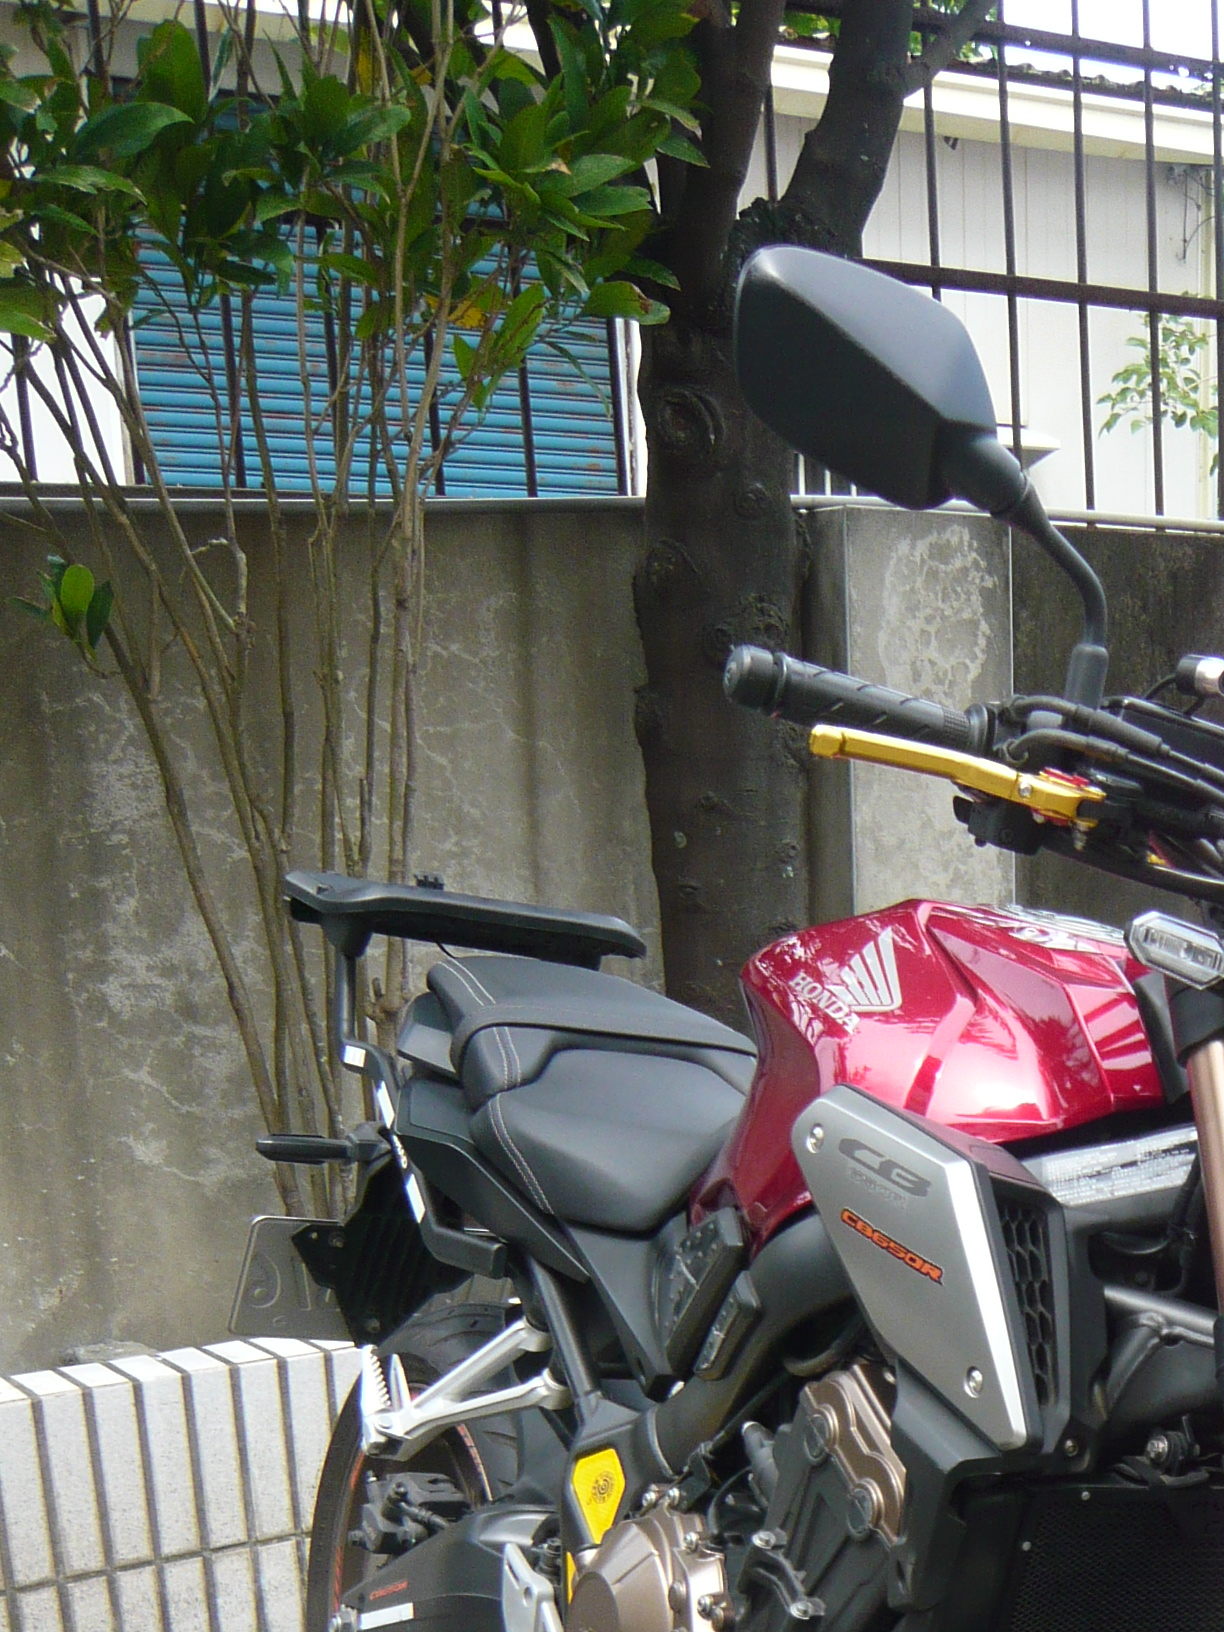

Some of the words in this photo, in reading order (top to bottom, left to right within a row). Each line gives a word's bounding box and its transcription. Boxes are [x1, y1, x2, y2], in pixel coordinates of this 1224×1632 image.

[789, 972, 860, 1035] HONDA
[838, 1138, 931, 1197] CB
[841, 1207, 943, 1284] CB650R
